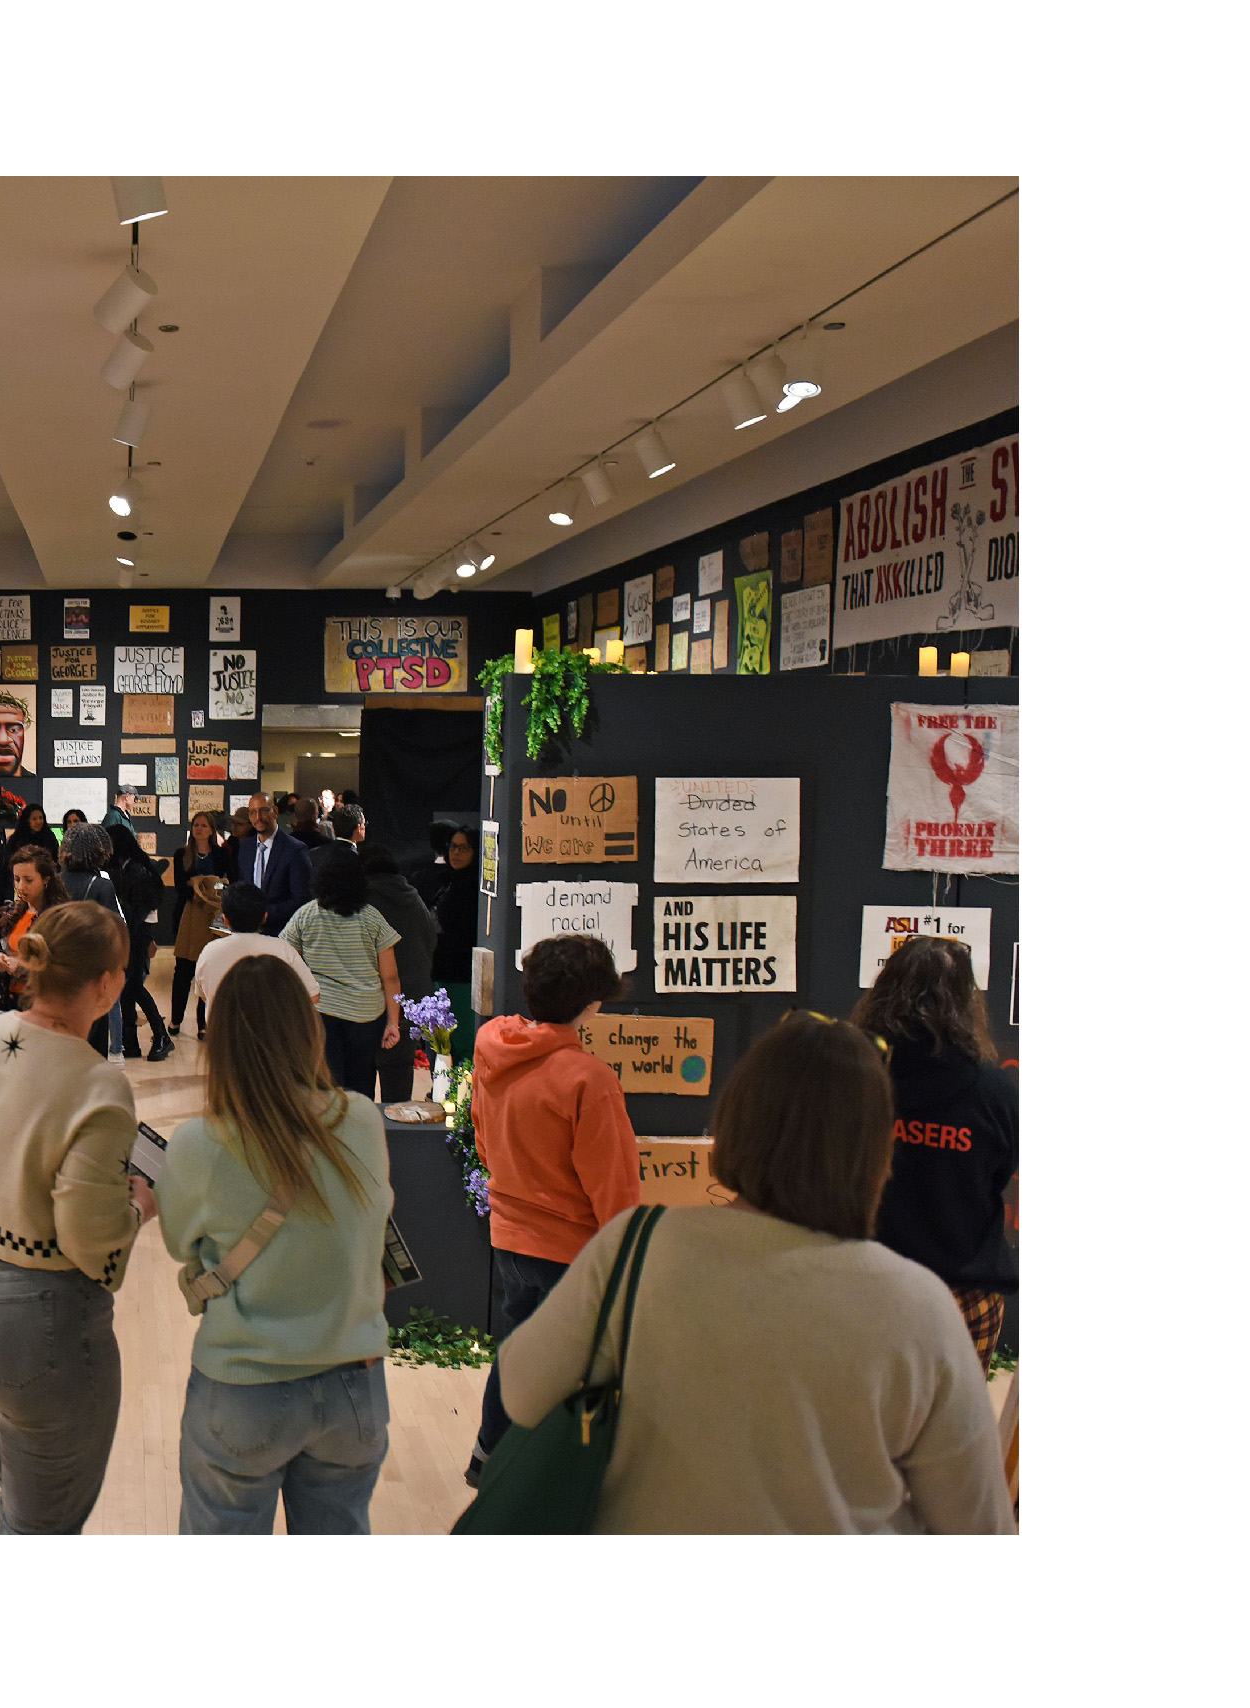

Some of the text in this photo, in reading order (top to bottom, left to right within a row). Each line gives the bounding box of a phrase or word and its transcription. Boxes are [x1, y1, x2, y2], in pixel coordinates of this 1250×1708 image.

[844, 467, 948, 562] ABOLISH
[962, 463, 975, 485] THE
[842, 569, 874, 610] THAT
[425, 620, 463, 640] OUR
[52, 647, 92, 658] JUSTICE
[118, 647, 180, 663] JUSTICE
[347, 637, 458, 660] COLLECTIVE
[52, 664, 88, 678] GEORGE
[135, 662, 166, 677] FOR
[223, 654, 246, 671] NO
[356, 655, 451, 691] PTSD
[117, 674, 183, 694] GEORGE FLOYD
[225, 692, 244, 704] NO
[917, 714, 997, 729] FREE THE
[57, 741, 94, 751] JUSTICE
[189, 740, 228, 756] Justice
[189, 755, 209, 767] For
[681, 780, 748, 795] UNITED
[529, 787, 567, 816] NO
[686, 793, 756, 812] Divided
[560, 815, 603, 828] until
[678, 818, 787, 838] States of
[915, 821, 996, 837] PHOENIX
[525, 836, 594, 856] We are
[914, 837, 994, 858] THREE
[684, 847, 764, 873] America
[546, 887, 612, 907] demand
[663, 901, 694, 916] AND
[552, 912, 600, 932] racial
[885, 915, 965, 933] ASU #1 for
[663, 922, 767, 951] HIS LIFE
[665, 956, 777, 986] MATTERS
[609, 1024, 659, 1055] change
[674, 1026, 697, 1049] the
[632, 1053, 673, 1074] world
[639, 1150, 700, 1181] First
